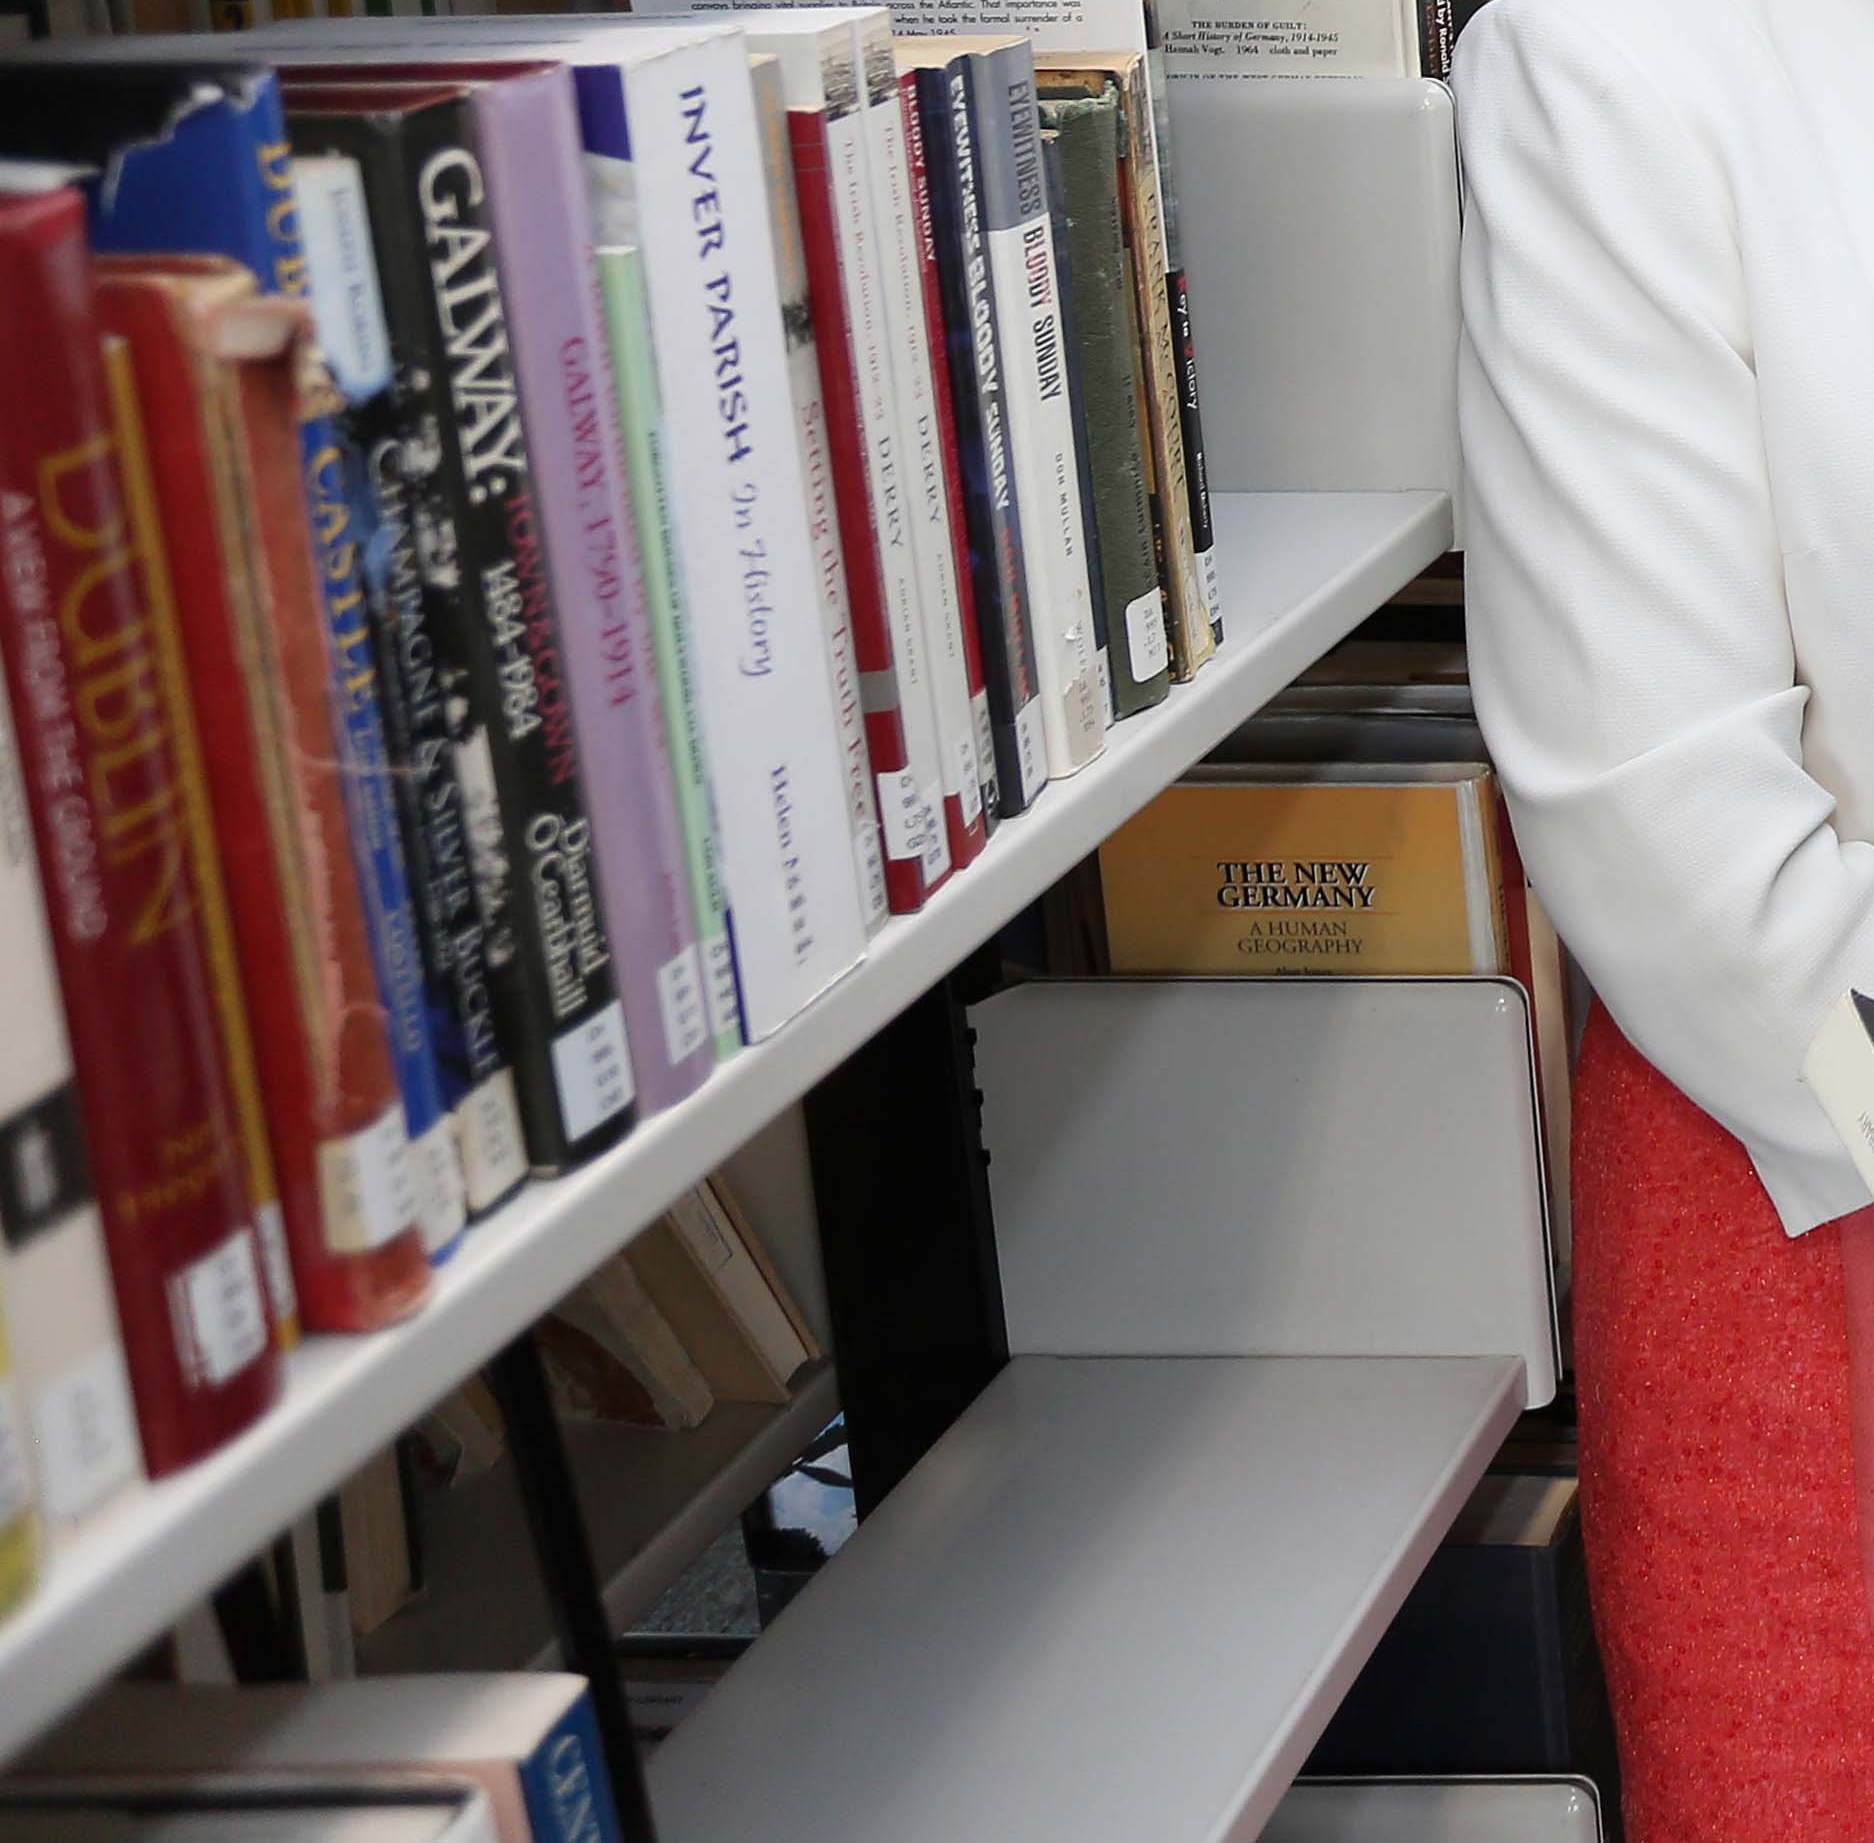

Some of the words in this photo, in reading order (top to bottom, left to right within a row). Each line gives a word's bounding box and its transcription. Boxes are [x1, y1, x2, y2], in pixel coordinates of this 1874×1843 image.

[1192, 21, 1212, 30] THE
[1214, 21, 1255, 30] BURDEN
[1256, 21, 1270, 30] OF
[1271, 22, 1307, 30] GUILT:
[679, 85, 725, 259] INVER
[906, 84, 924, 169] BLOODY
[918, 175, 937, 262] SUNDAY
[1005, 81, 1042, 217] EYEWITNESS
[418, 147, 529, 504] GALWAY:
[950, 74, 981, 253] EYEWITNESS
[967, 254, 999, 396] BLOODY
[985, 402, 1011, 512] SUNDAY
[1022, 228, 1052, 312] BLOODY
[704, 272, 754, 464] PARISH
[1033, 314, 1061, 404] SUNDAY
[731, 482, 758, 529] In
[874, 435, 906, 550] DERRY
[918, 414, 943, 527] DERRY
[480, 559, 542, 741] 1484-1984
[734, 540, 774, 679] History
[558, 816, 610, 975] Diarmuid
[1216, 861, 1288, 886] THE
[1294, 861, 1370, 886] NEW
[1216, 886, 1376, 910] GERMANY
[1249, 920, 1263, 936] A
[1268, 920, 1348, 937] HUMAN
[1237, 938, 1363, 956] GEOGRAPHY
